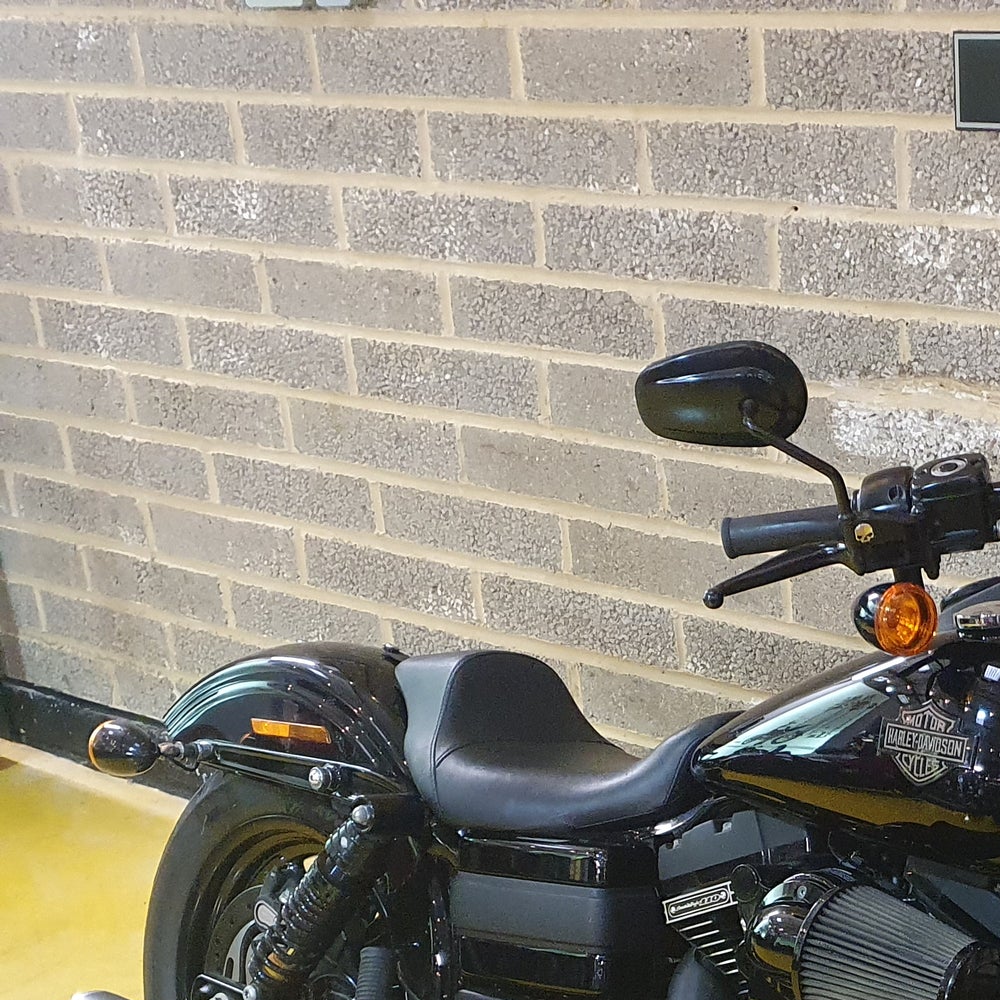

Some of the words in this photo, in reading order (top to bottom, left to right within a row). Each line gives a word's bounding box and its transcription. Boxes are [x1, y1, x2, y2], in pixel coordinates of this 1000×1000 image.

[905, 710, 946, 733] MOTOR
[887, 727, 963, 758] HARLEY-DAVIDSON
[902, 753, 940, 778] CYCLES
